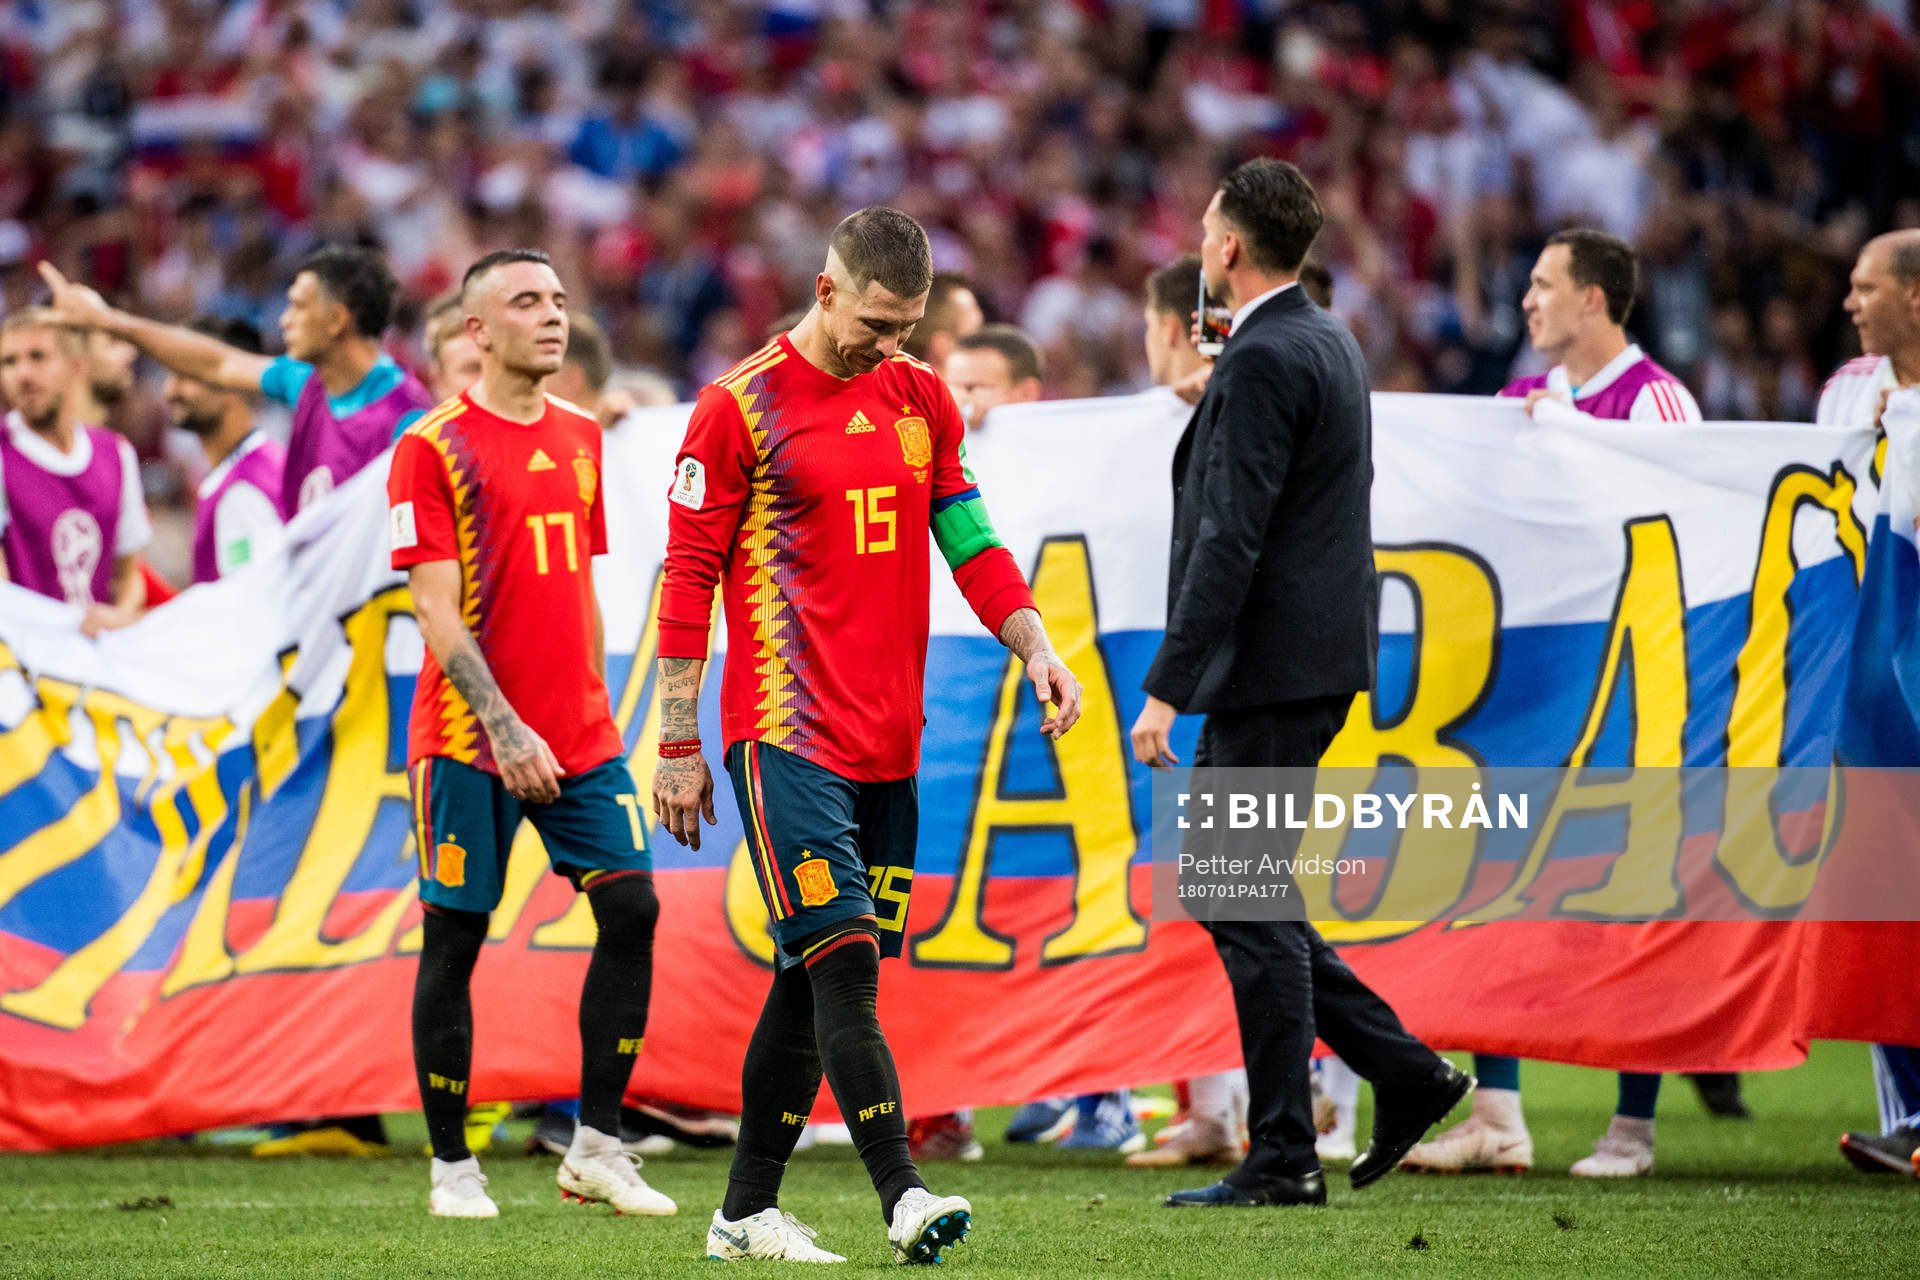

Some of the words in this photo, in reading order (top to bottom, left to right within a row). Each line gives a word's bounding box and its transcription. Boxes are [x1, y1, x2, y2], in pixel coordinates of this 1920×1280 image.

[845, 424, 876, 435] adidas
[526, 512, 578, 575] 17
[846, 486, 896, 554] 15
[615, 793, 648, 851] 1
[858, 1101, 897, 1122] RFEF
